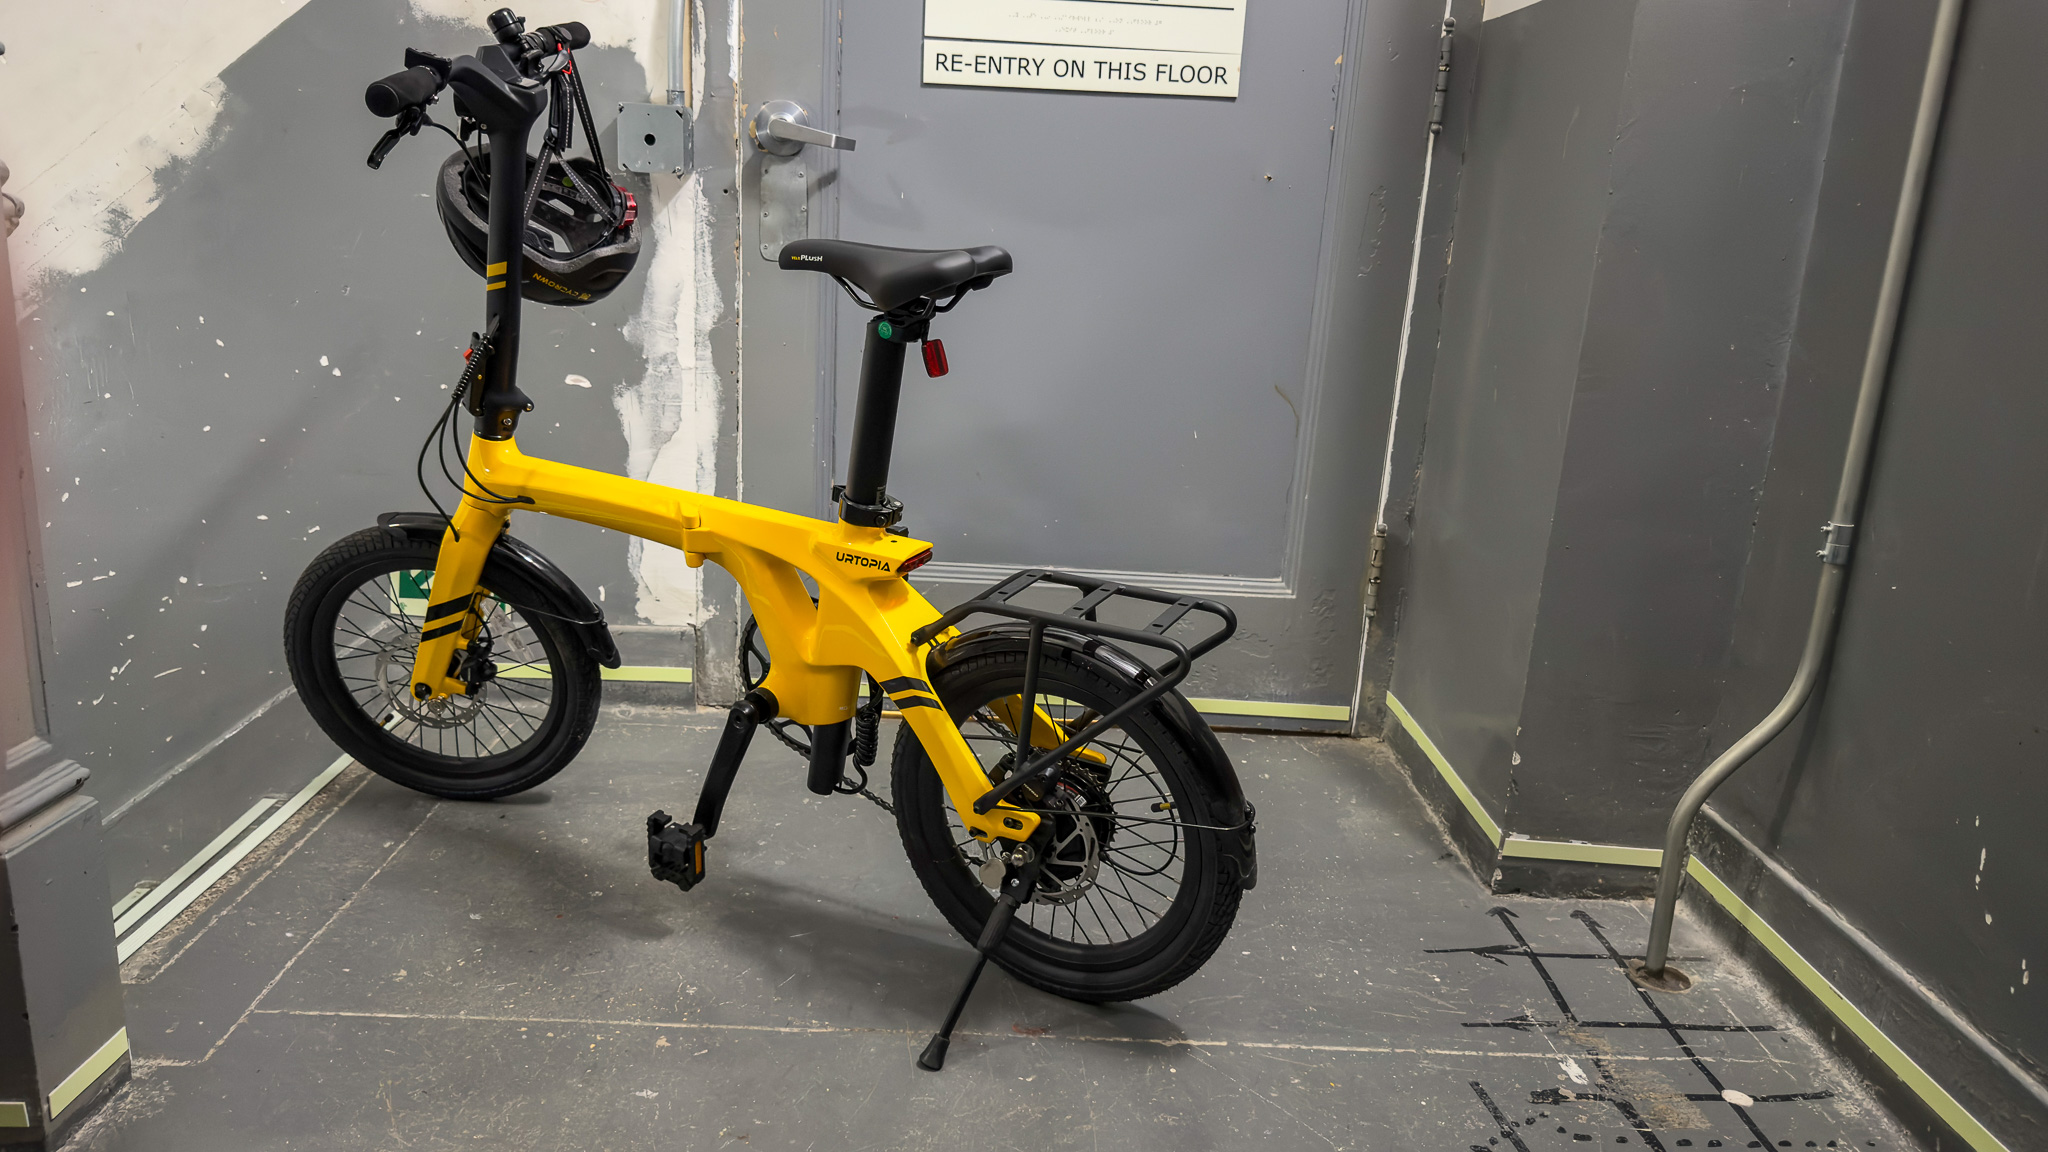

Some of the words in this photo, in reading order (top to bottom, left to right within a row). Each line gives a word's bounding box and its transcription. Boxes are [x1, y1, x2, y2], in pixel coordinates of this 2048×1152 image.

[935, 53, 1045, 76] RE-ENTRY
[1053, 59, 1085, 78] ON
[1094, 61, 1147, 81] THIS
[1156, 64, 1228, 85] FLOOR
[532, 272, 579, 297] CYCROWN
[836, 552, 891, 572] URTOPIA
